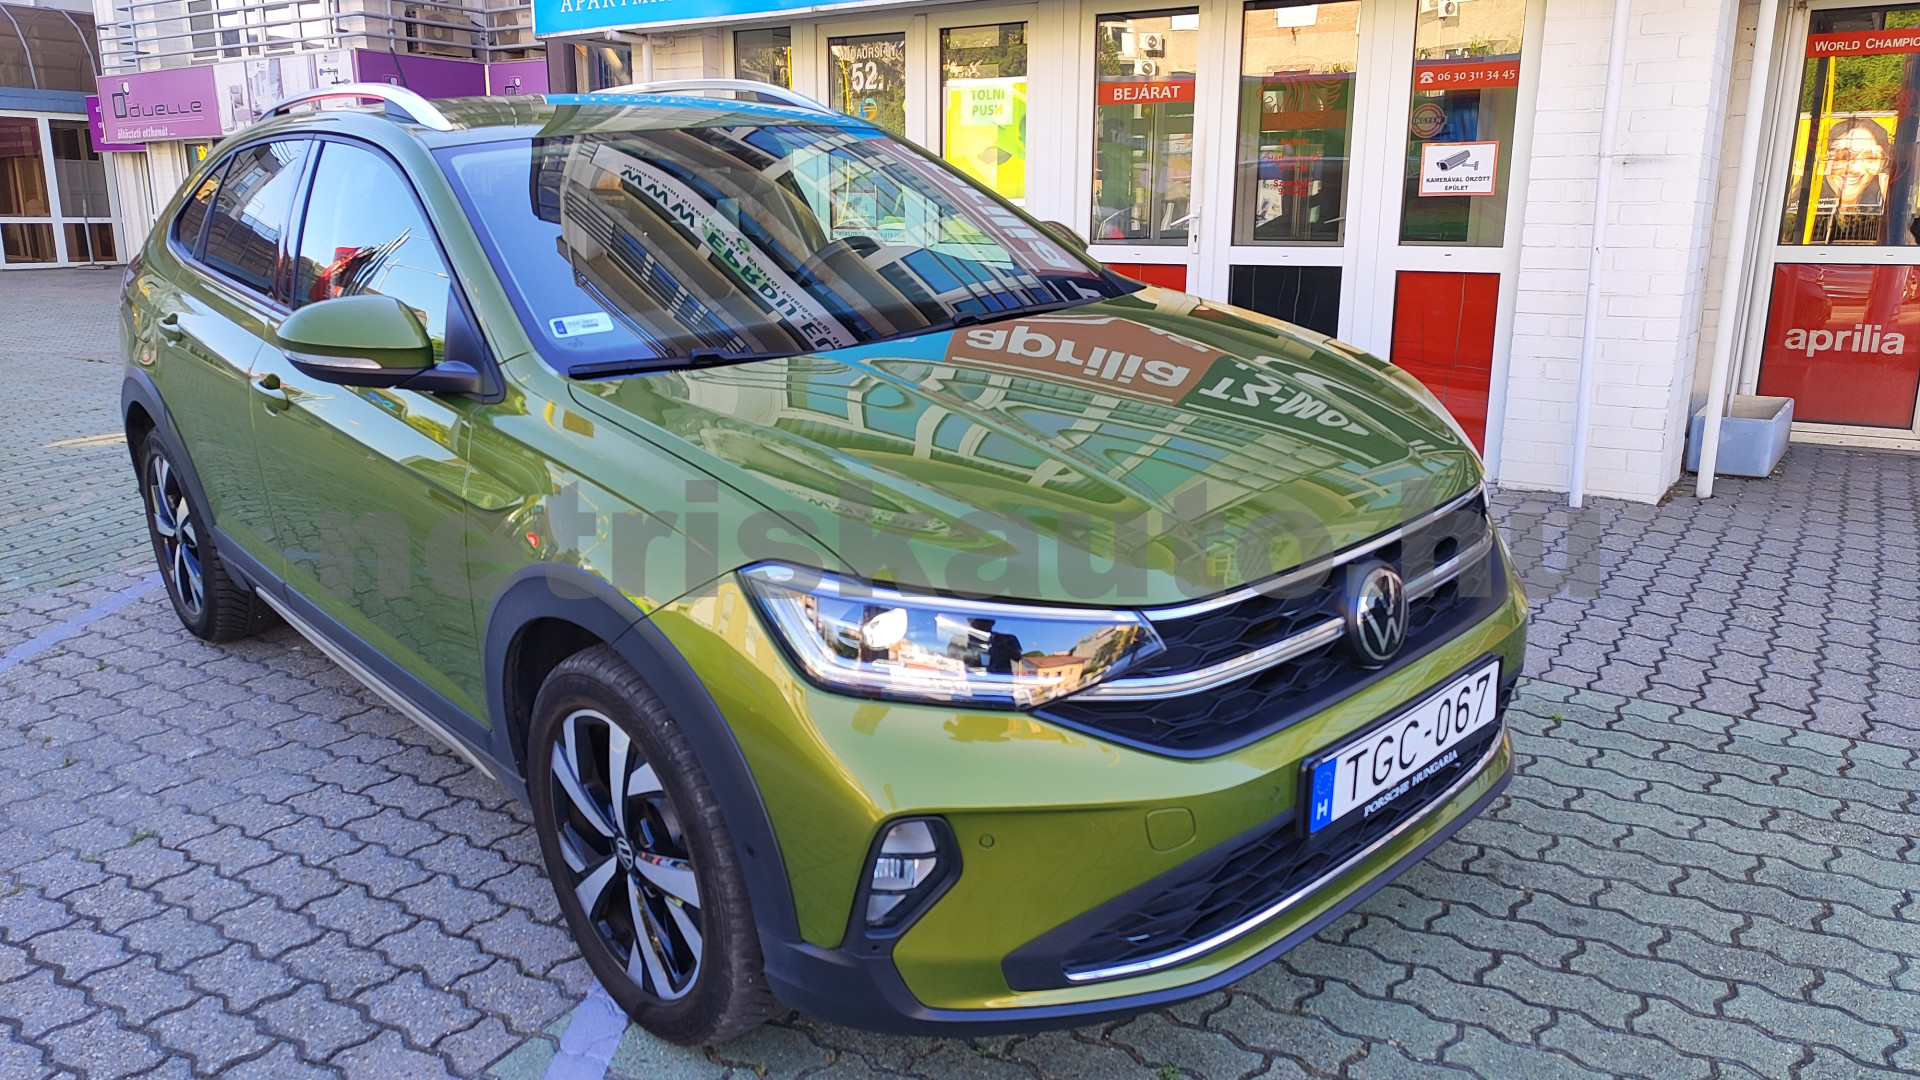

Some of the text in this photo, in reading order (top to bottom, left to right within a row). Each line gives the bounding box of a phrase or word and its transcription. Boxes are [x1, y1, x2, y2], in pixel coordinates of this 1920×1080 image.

[1815, 40, 1861, 52] WORLD
[1437, 69, 1516, 82] 06 30 311 34 45
[970, 88, 1005, 101] TOLNI
[1113, 84, 1181, 101] BEJÁRAT
[972, 103, 1003, 116] PUSH
[1425, 175, 1464, 183] KAMERÁVAL
[1784, 323, 1905, 358] aprilia
[1347, 672, 1491, 801] TGC-067
[1363, 749, 1459, 818] PORSCHE HUNGARIA
[1316, 797, 1329, 822] H
